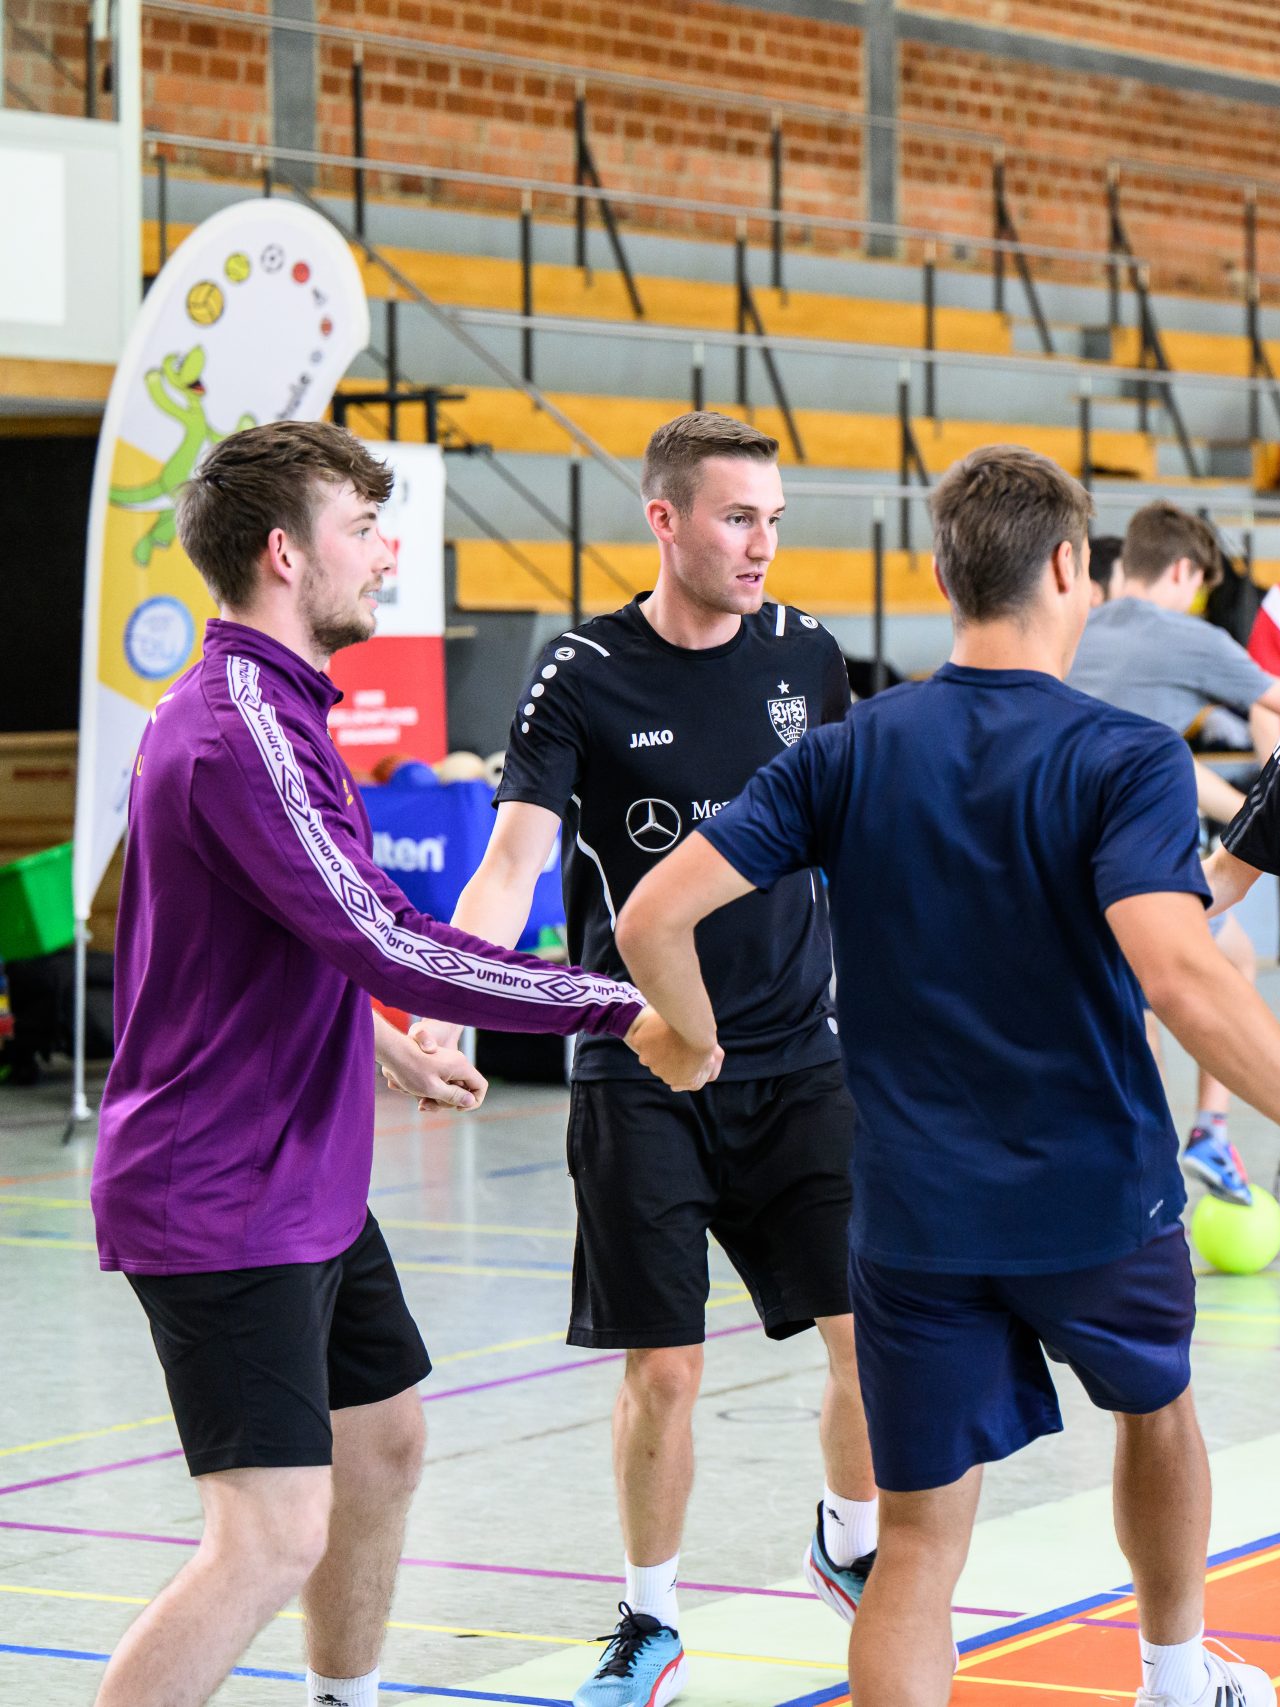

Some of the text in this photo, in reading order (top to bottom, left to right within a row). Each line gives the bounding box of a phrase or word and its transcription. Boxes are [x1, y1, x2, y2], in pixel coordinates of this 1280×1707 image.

[629, 729, 674, 749] JAKO
[308, 822, 342, 873] umbro
[372, 831, 446, 873] lten
[476, 967, 532, 990] umbro
